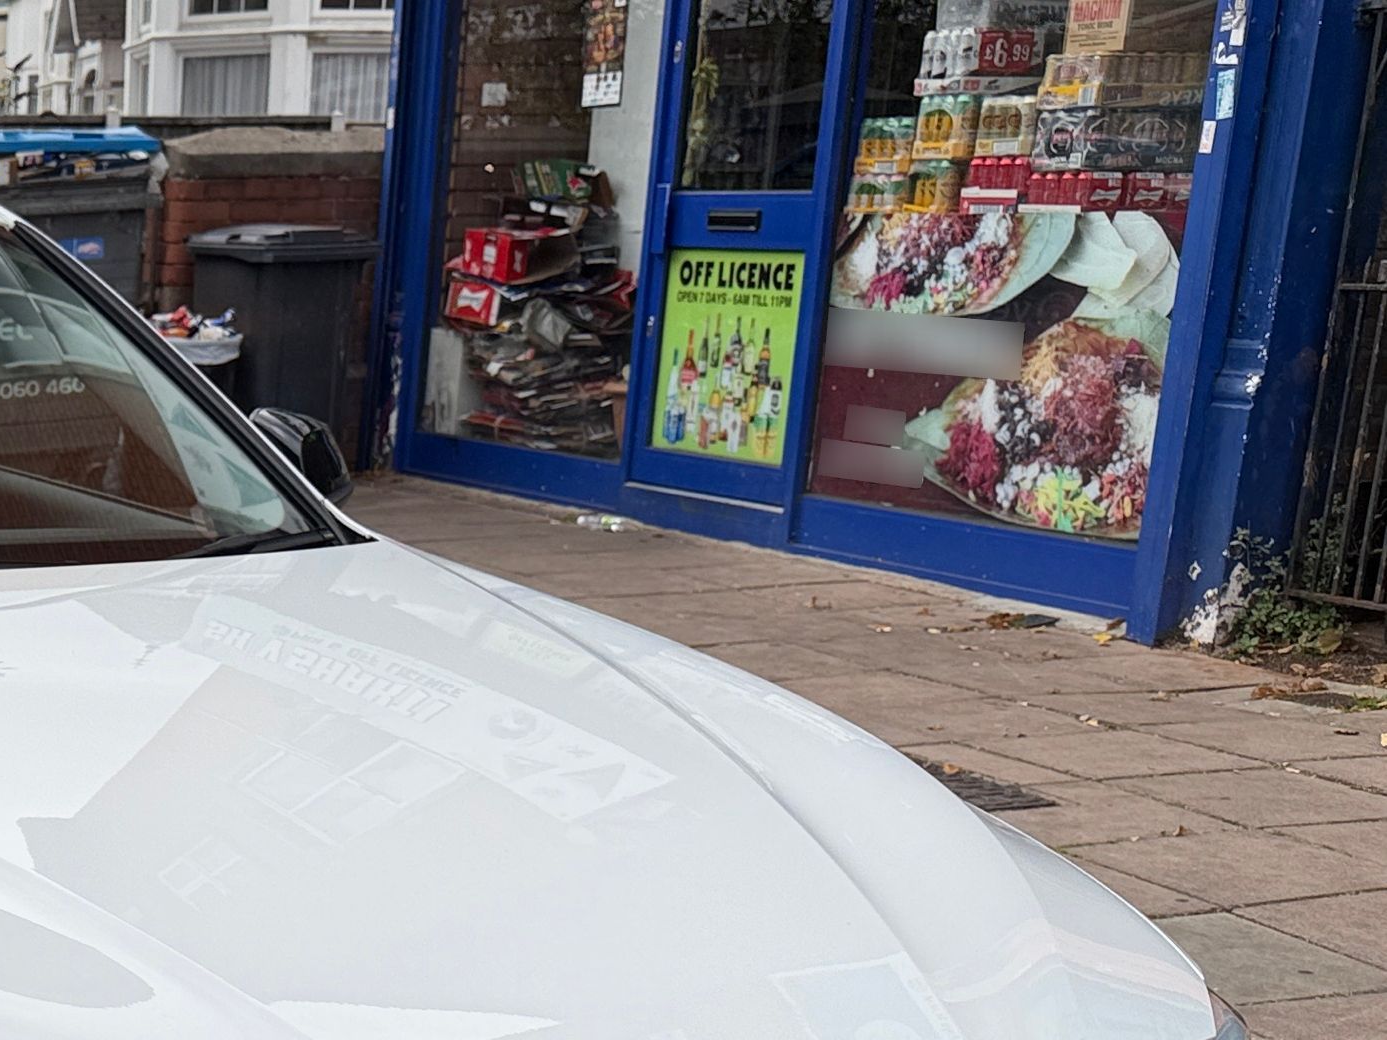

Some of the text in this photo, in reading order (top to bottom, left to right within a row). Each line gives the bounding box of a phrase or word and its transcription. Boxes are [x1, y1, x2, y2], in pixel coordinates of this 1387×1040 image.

[983, 38, 1030, 68] £6.99
[680, 260, 796, 291] OFF LICENCE
[677, 290, 697, 303] OPEN
[705, 293, 727, 305] DAYS
[752, 295, 769, 307] TILL
